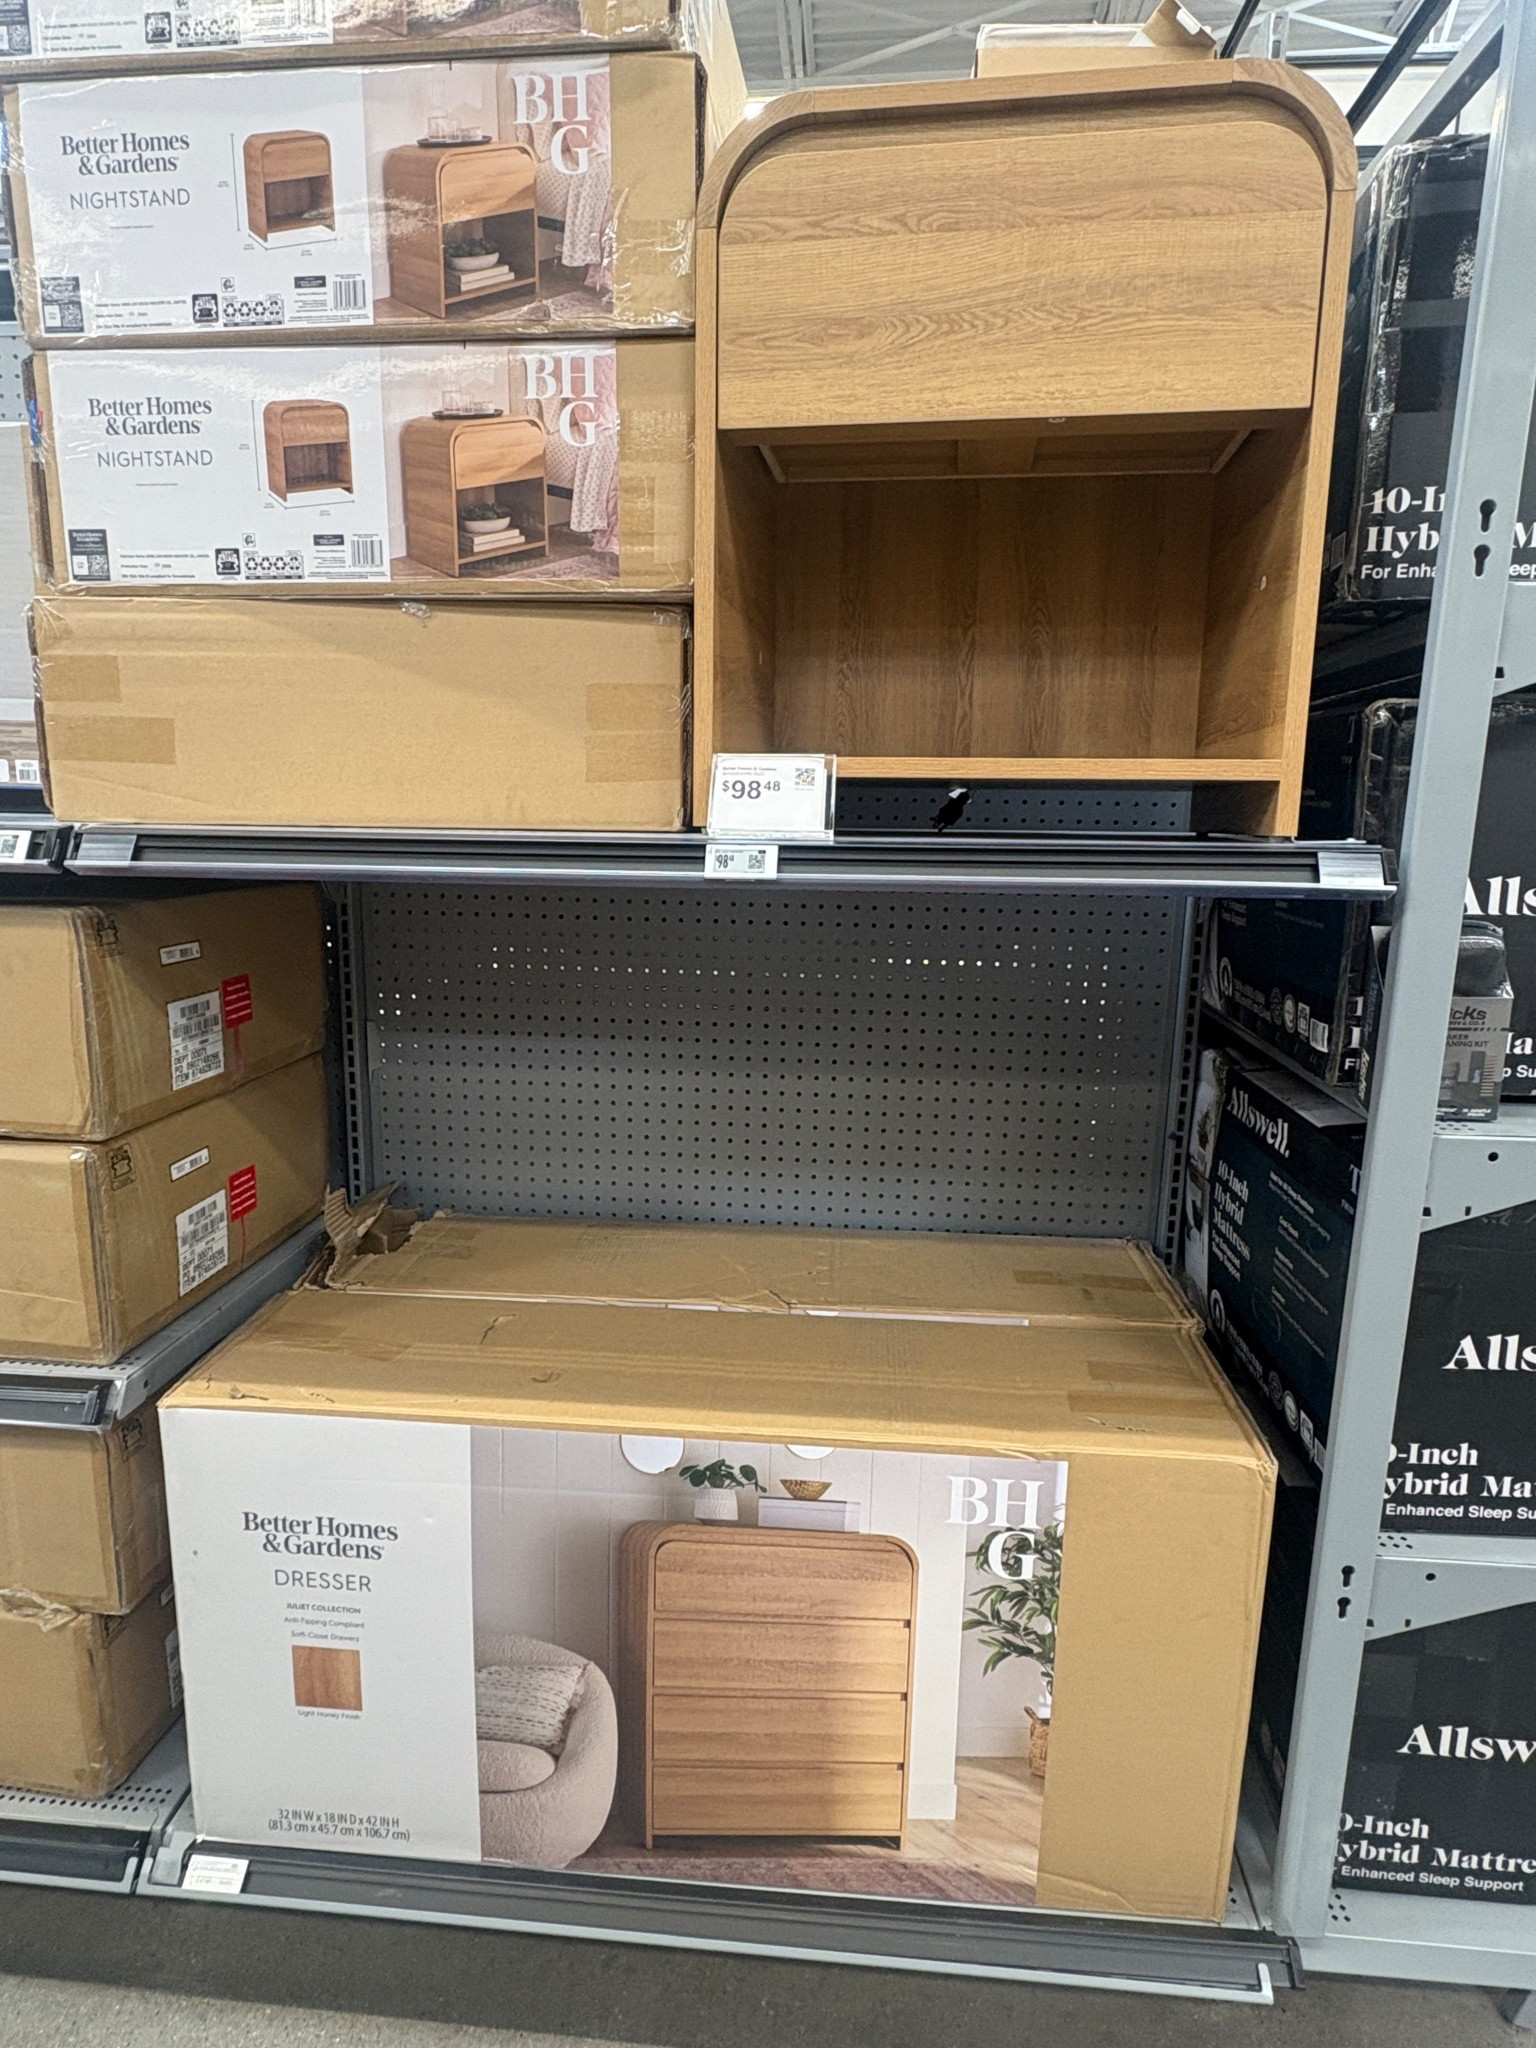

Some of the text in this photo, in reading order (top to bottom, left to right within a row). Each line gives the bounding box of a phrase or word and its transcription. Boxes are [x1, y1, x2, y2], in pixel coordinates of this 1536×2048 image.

[60, 133, 190, 155] Better Homes
[70, 188, 190, 210] NIGHTSTAND
[88, 397, 212, 416] Better Homes
[97, 450, 213, 467] NIGHTSTAND
[1361, 565, 1391, 580] For
[1217, 1159, 1249, 1203] 10-Inch
[1214, 1181, 1245, 1226] Hybrid
[1213, 1206, 1251, 1261] Mattress
[944, 1475, 1045, 1529] BH
[1386, 1503, 1464, 1518] Enhanced
[1468, 1506, 1512, 1521] Sleep
[242, 1512, 398, 1541] Better Homes
[274, 1569, 372, 1592] DRESSER
[311, 1604, 361, 1614] COLLECTION
[284, 1617, 365, 1629] Anti-Tipping Compliant
[291, 1631, 359, 1642] Soft-Close Drawers
[278, 1809, 290, 1820] 32
[291, 1810, 301, 1820] IN
[302, 1811, 314, 1822] W
[324, 1812, 337, 1823] 18
[338, 1813, 347, 1824] IN
[349, 1814, 357, 1824] D
[366, 1815, 378, 1826] 42
[380, 1817, 390, 1827] IN
[392, 1817, 400, 1827] H
[268, 1819, 292, 1833] (81.3
[294, 1824, 308, 1833] cm
[310, 1825, 316, 1833] x
[318, 1822, 338, 1834] 45.7
[340, 1826, 355, 1835] cm
[365, 1827, 390, 1839] 106.7
[392, 1829, 410, 1841] cm)
[1341, 1865, 1525, 1892] Enhanced Sleep Support
